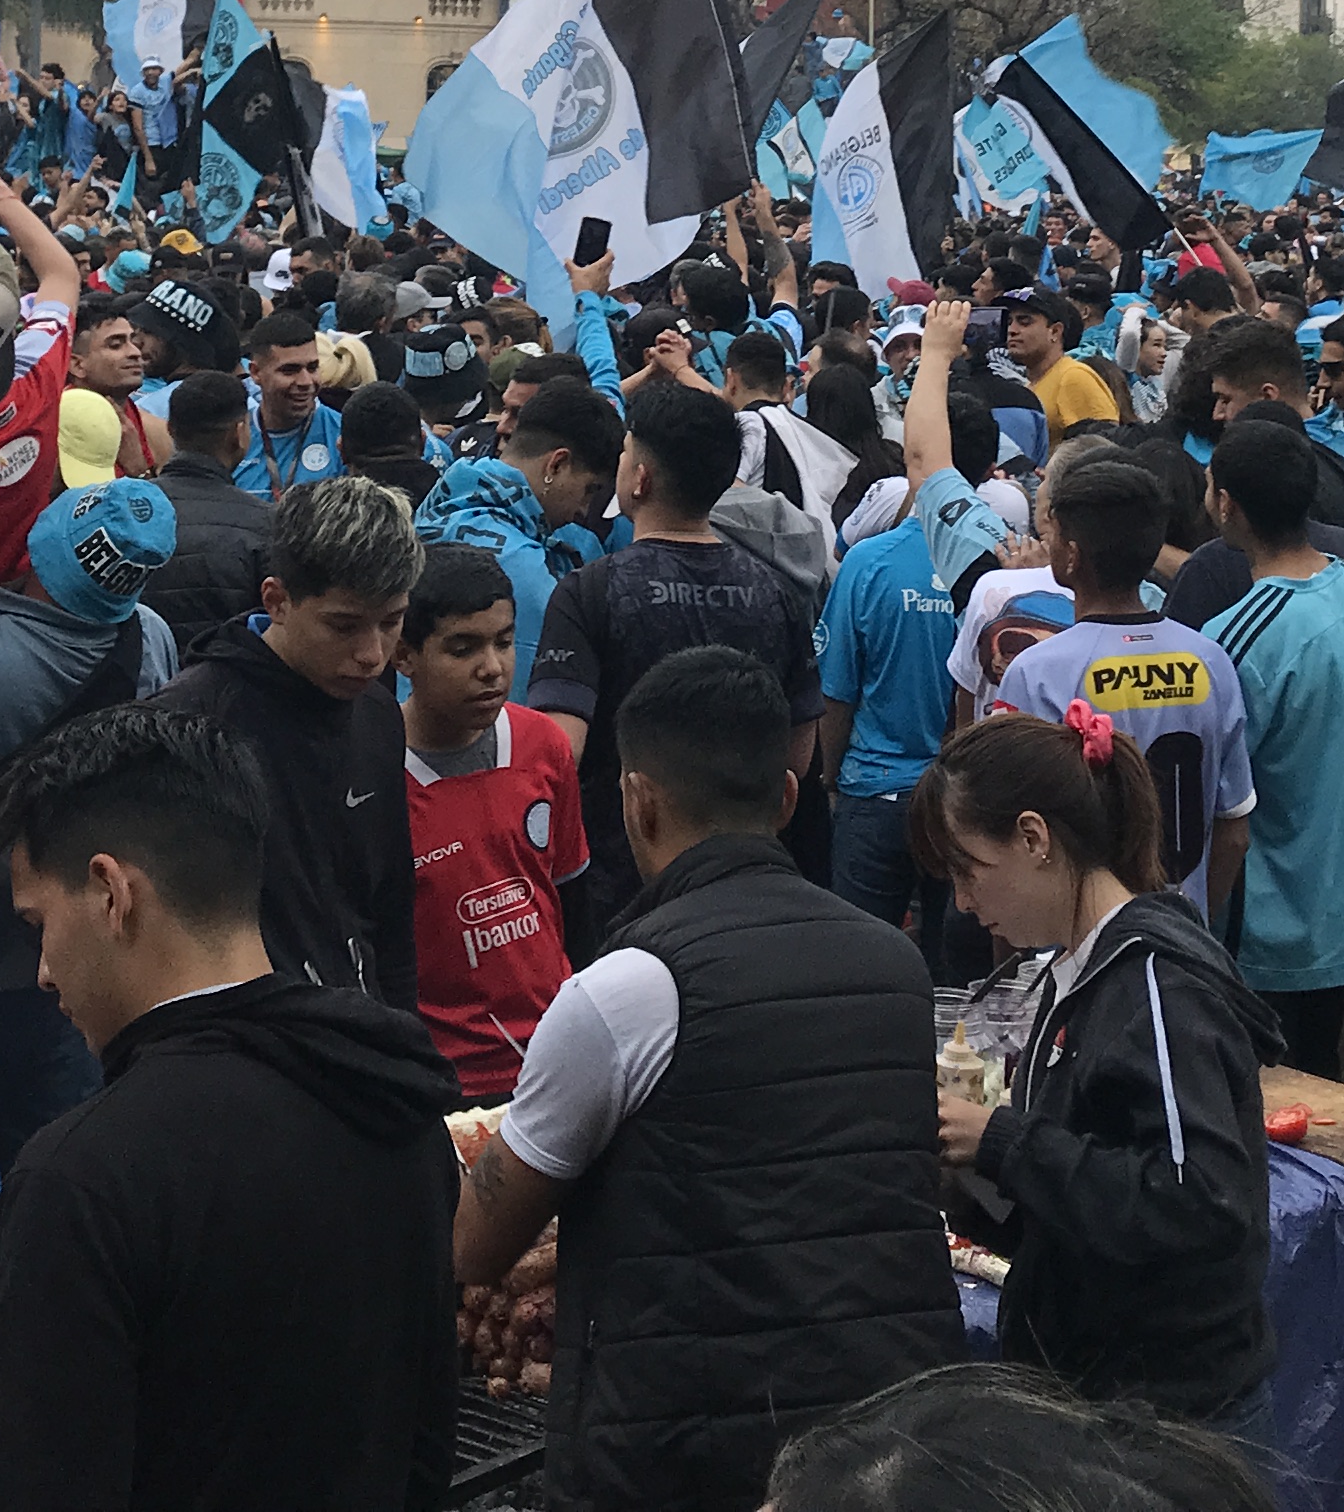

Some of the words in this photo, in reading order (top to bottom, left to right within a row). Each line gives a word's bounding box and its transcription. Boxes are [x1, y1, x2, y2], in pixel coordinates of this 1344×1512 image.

[648, 580, 754, 608] DIRECTV
[1092, 662, 1200, 695] PAUNY
[464, 885, 526, 918] Tersuave
